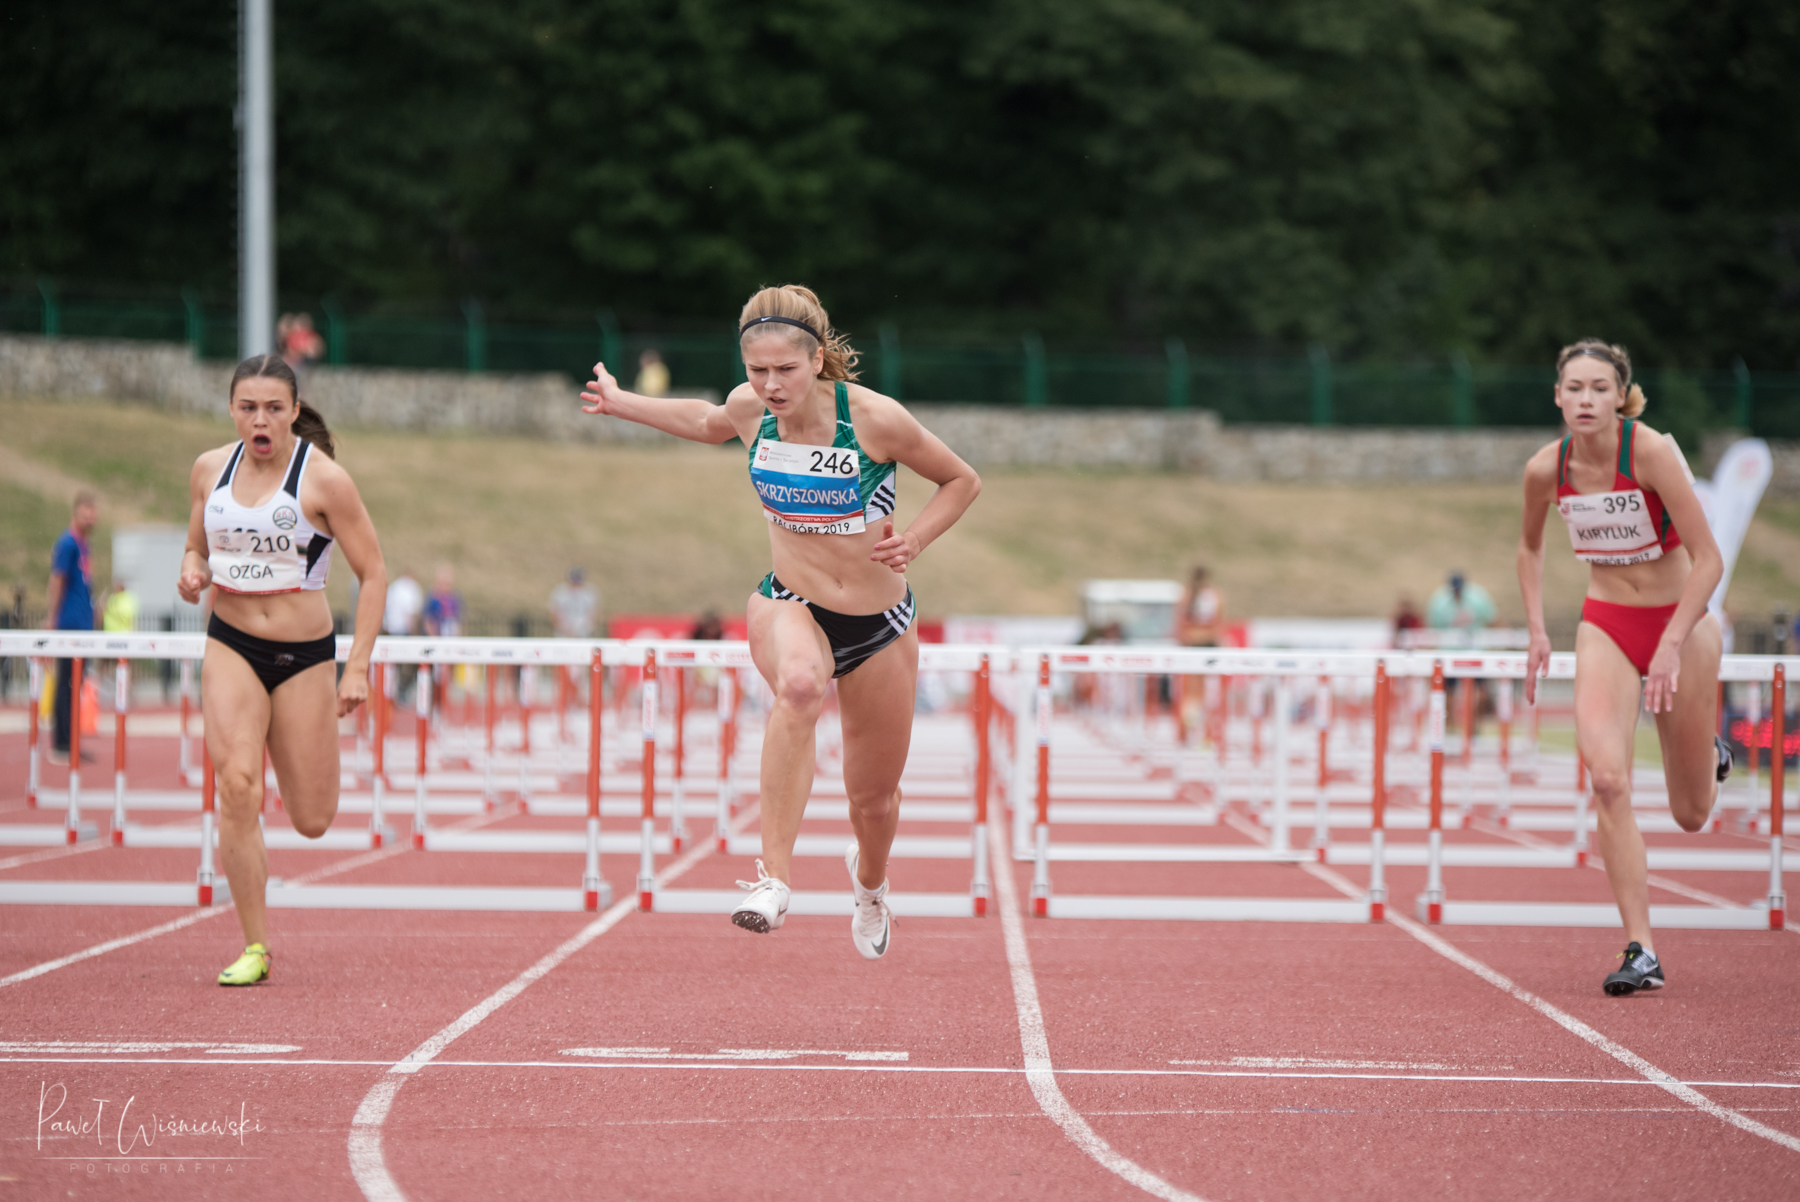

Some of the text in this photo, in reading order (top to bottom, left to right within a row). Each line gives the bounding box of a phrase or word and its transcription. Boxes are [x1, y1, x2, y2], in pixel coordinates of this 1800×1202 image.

[809, 450, 854, 475] 246
[755, 480, 859, 506] SKRZYSZOWSKA
[1603, 494, 1640, 514] 395
[823, 522, 850, 535] 2019
[1576, 525, 1641, 541] KIRYLUK
[250, 534, 290, 553] 210
[1628, 552, 1650, 566] 2019
[229, 564, 274, 580] OZGA
